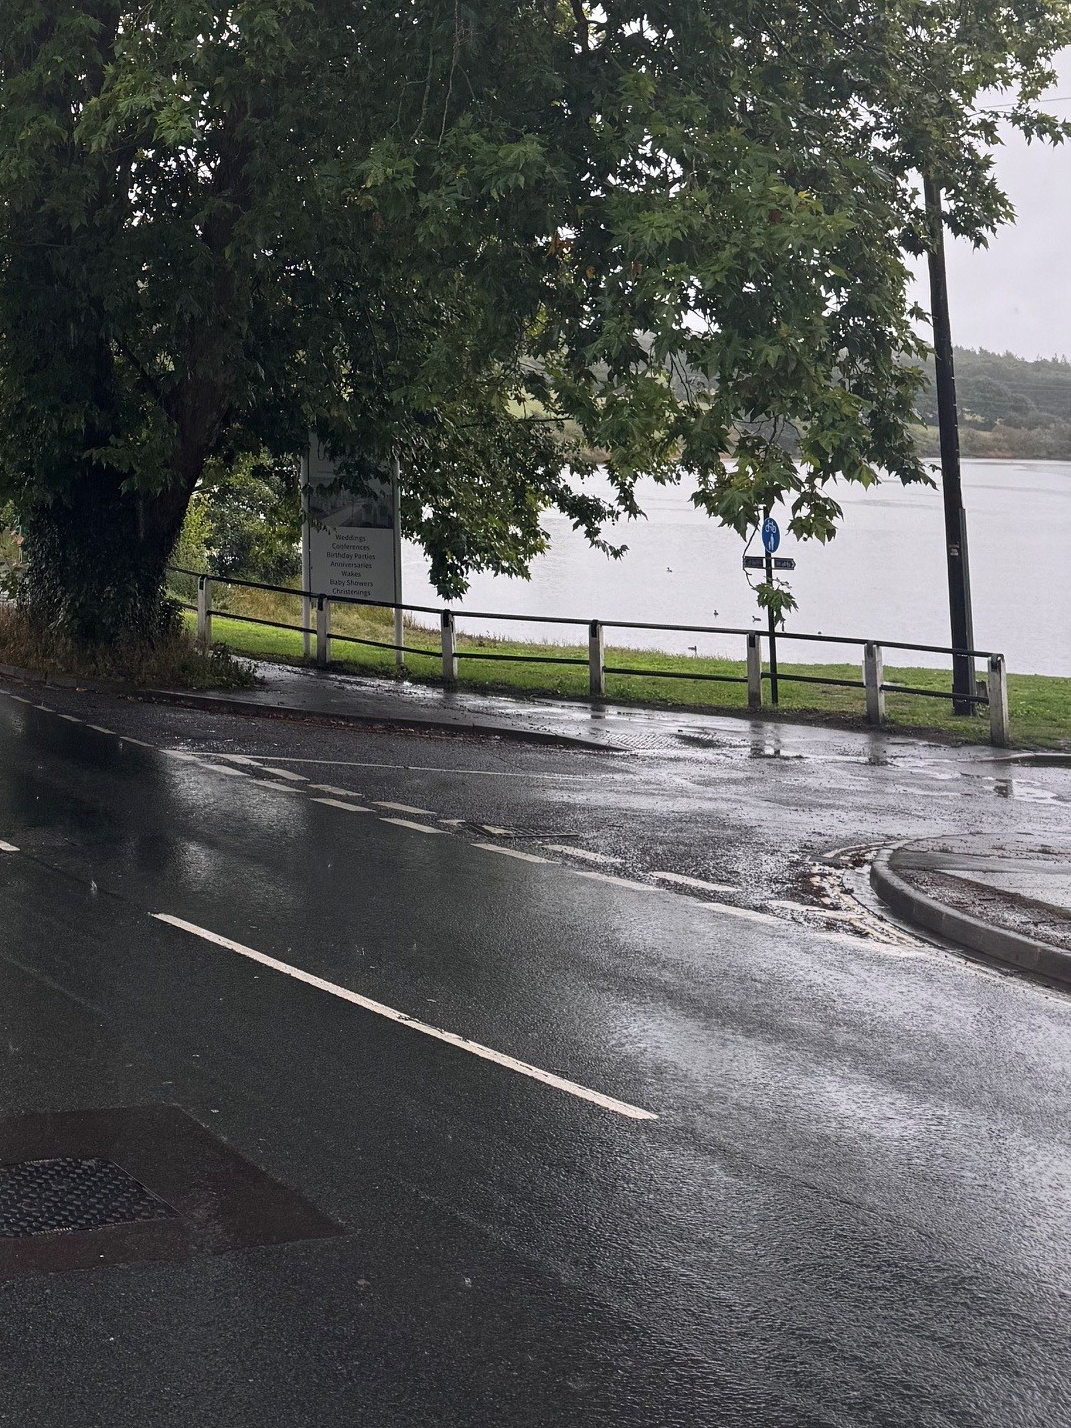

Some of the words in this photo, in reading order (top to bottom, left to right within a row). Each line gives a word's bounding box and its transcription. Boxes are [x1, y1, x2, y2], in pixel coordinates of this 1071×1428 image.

[335, 534, 366, 543] Weddings
[331, 543, 371, 552] Conferences
[326, 552, 354, 561] Birthday
[354, 553, 376, 561] Parties
[330, 561, 373, 570] Anniversaries
[330, 579, 345, 587] Baby
[346, 579, 374, 587] Showers
[332, 588, 372, 597] Christenings
